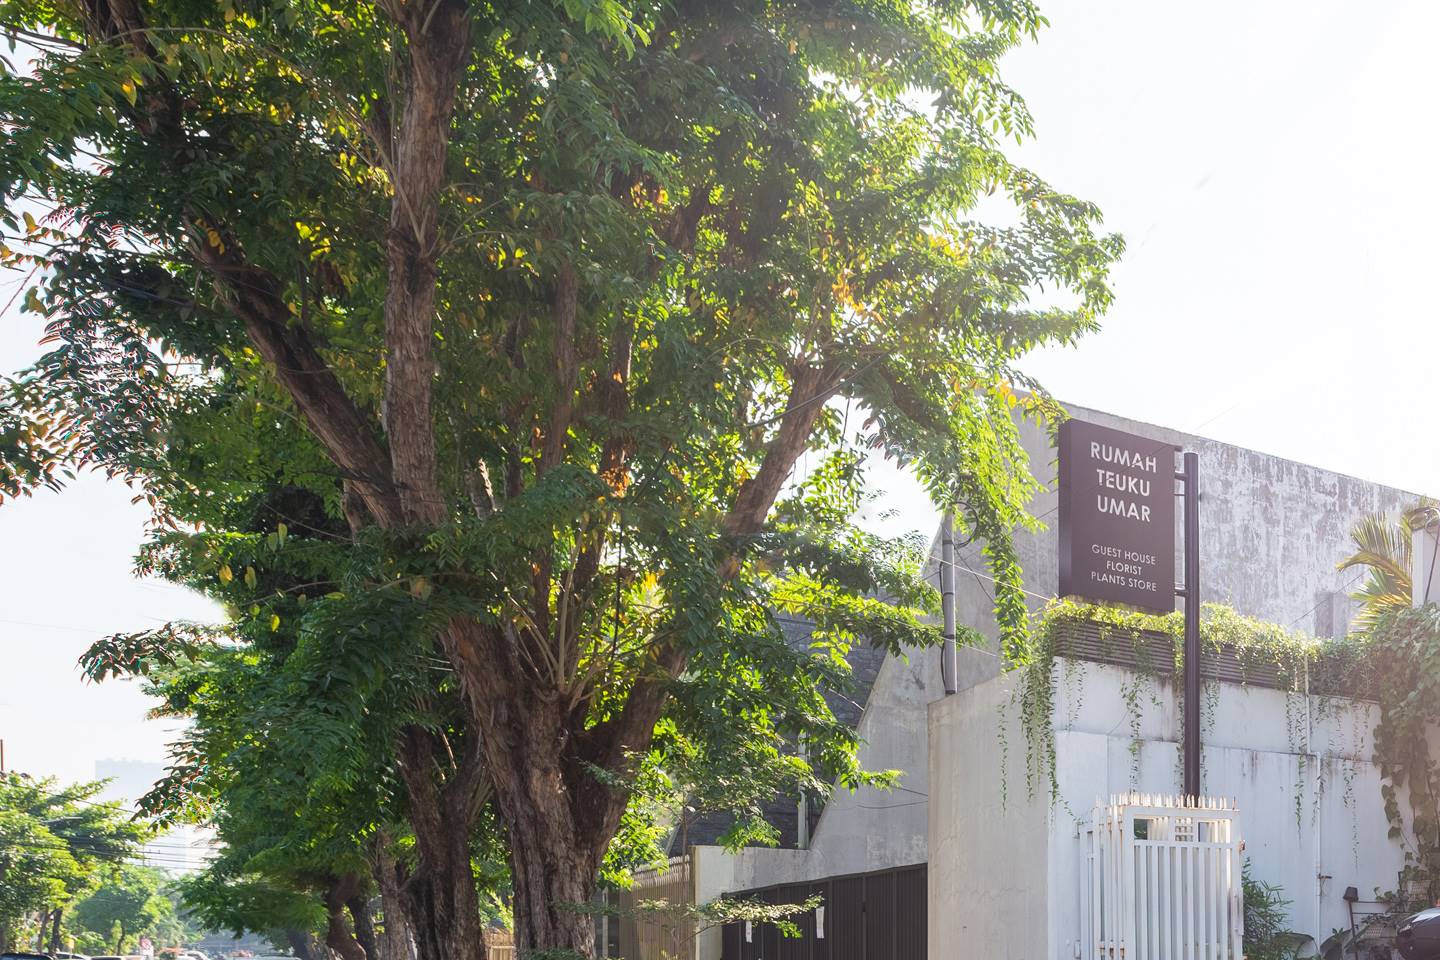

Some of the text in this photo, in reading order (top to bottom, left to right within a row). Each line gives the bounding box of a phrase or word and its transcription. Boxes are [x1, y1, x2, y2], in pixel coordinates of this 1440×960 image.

[1090, 441, 1157, 473] RUMAH
[1096, 469, 1151, 497] TEUKU
[1097, 495, 1151, 522] UMAR
[1091, 544, 1156, 565] GUEST HOUSE
[1106, 561, 1142, 575] FLORIST
[1091, 571, 1157, 592] PLANTS STORE
